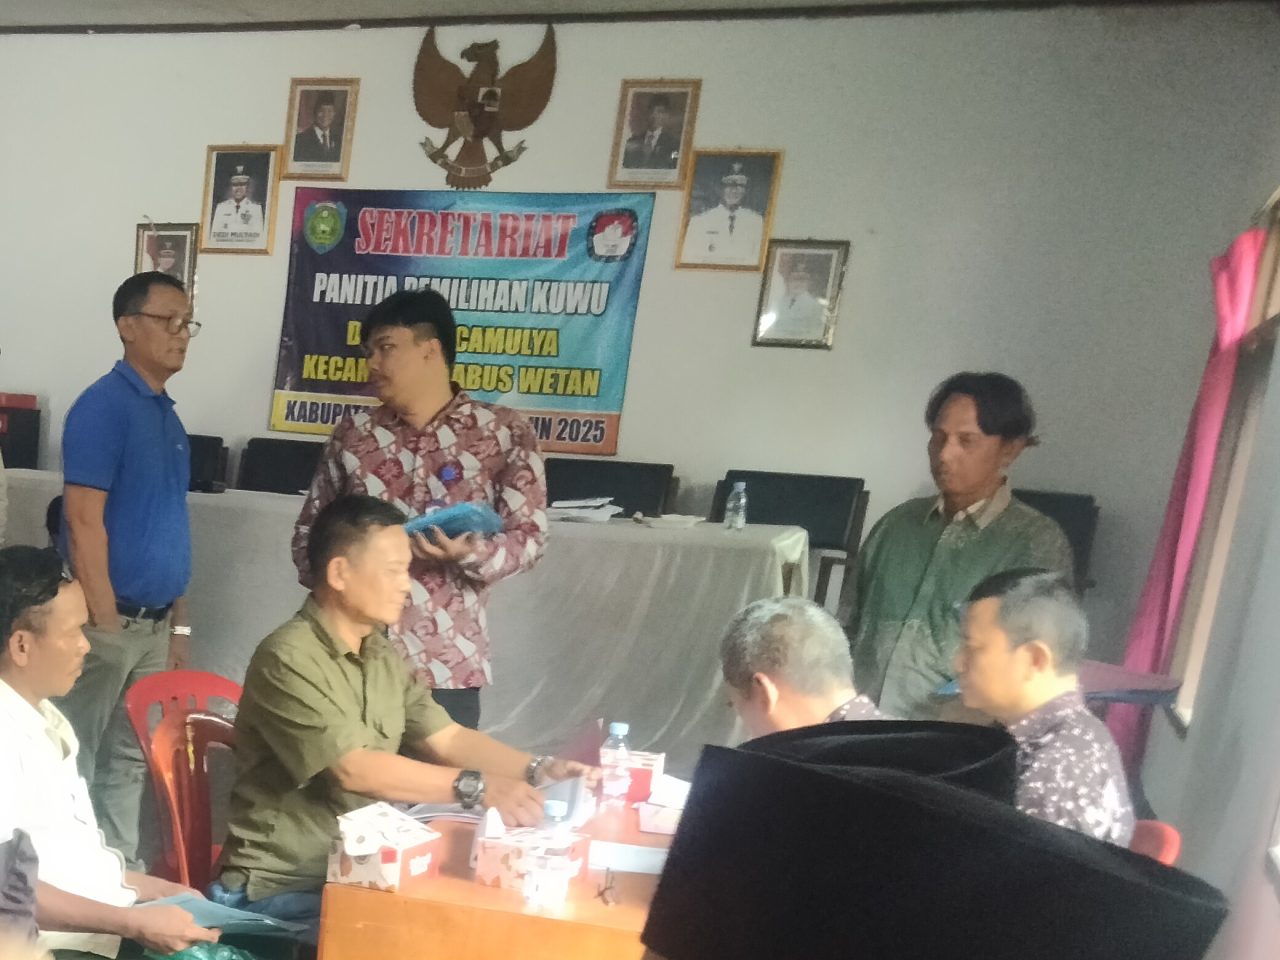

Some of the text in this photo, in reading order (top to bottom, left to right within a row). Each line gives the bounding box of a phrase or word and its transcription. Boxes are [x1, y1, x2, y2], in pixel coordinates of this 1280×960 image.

[355, 208, 577, 259] SEKRETARIAT
[312, 272, 399, 305] PANITIA
[530, 280, 610, 316] KUWU
[455, 326, 559, 356] CAMULYA
[452, 363, 514, 393] ABUS
[518, 367, 601, 396] WETAN
[556, 418, 606, 444] 2025
